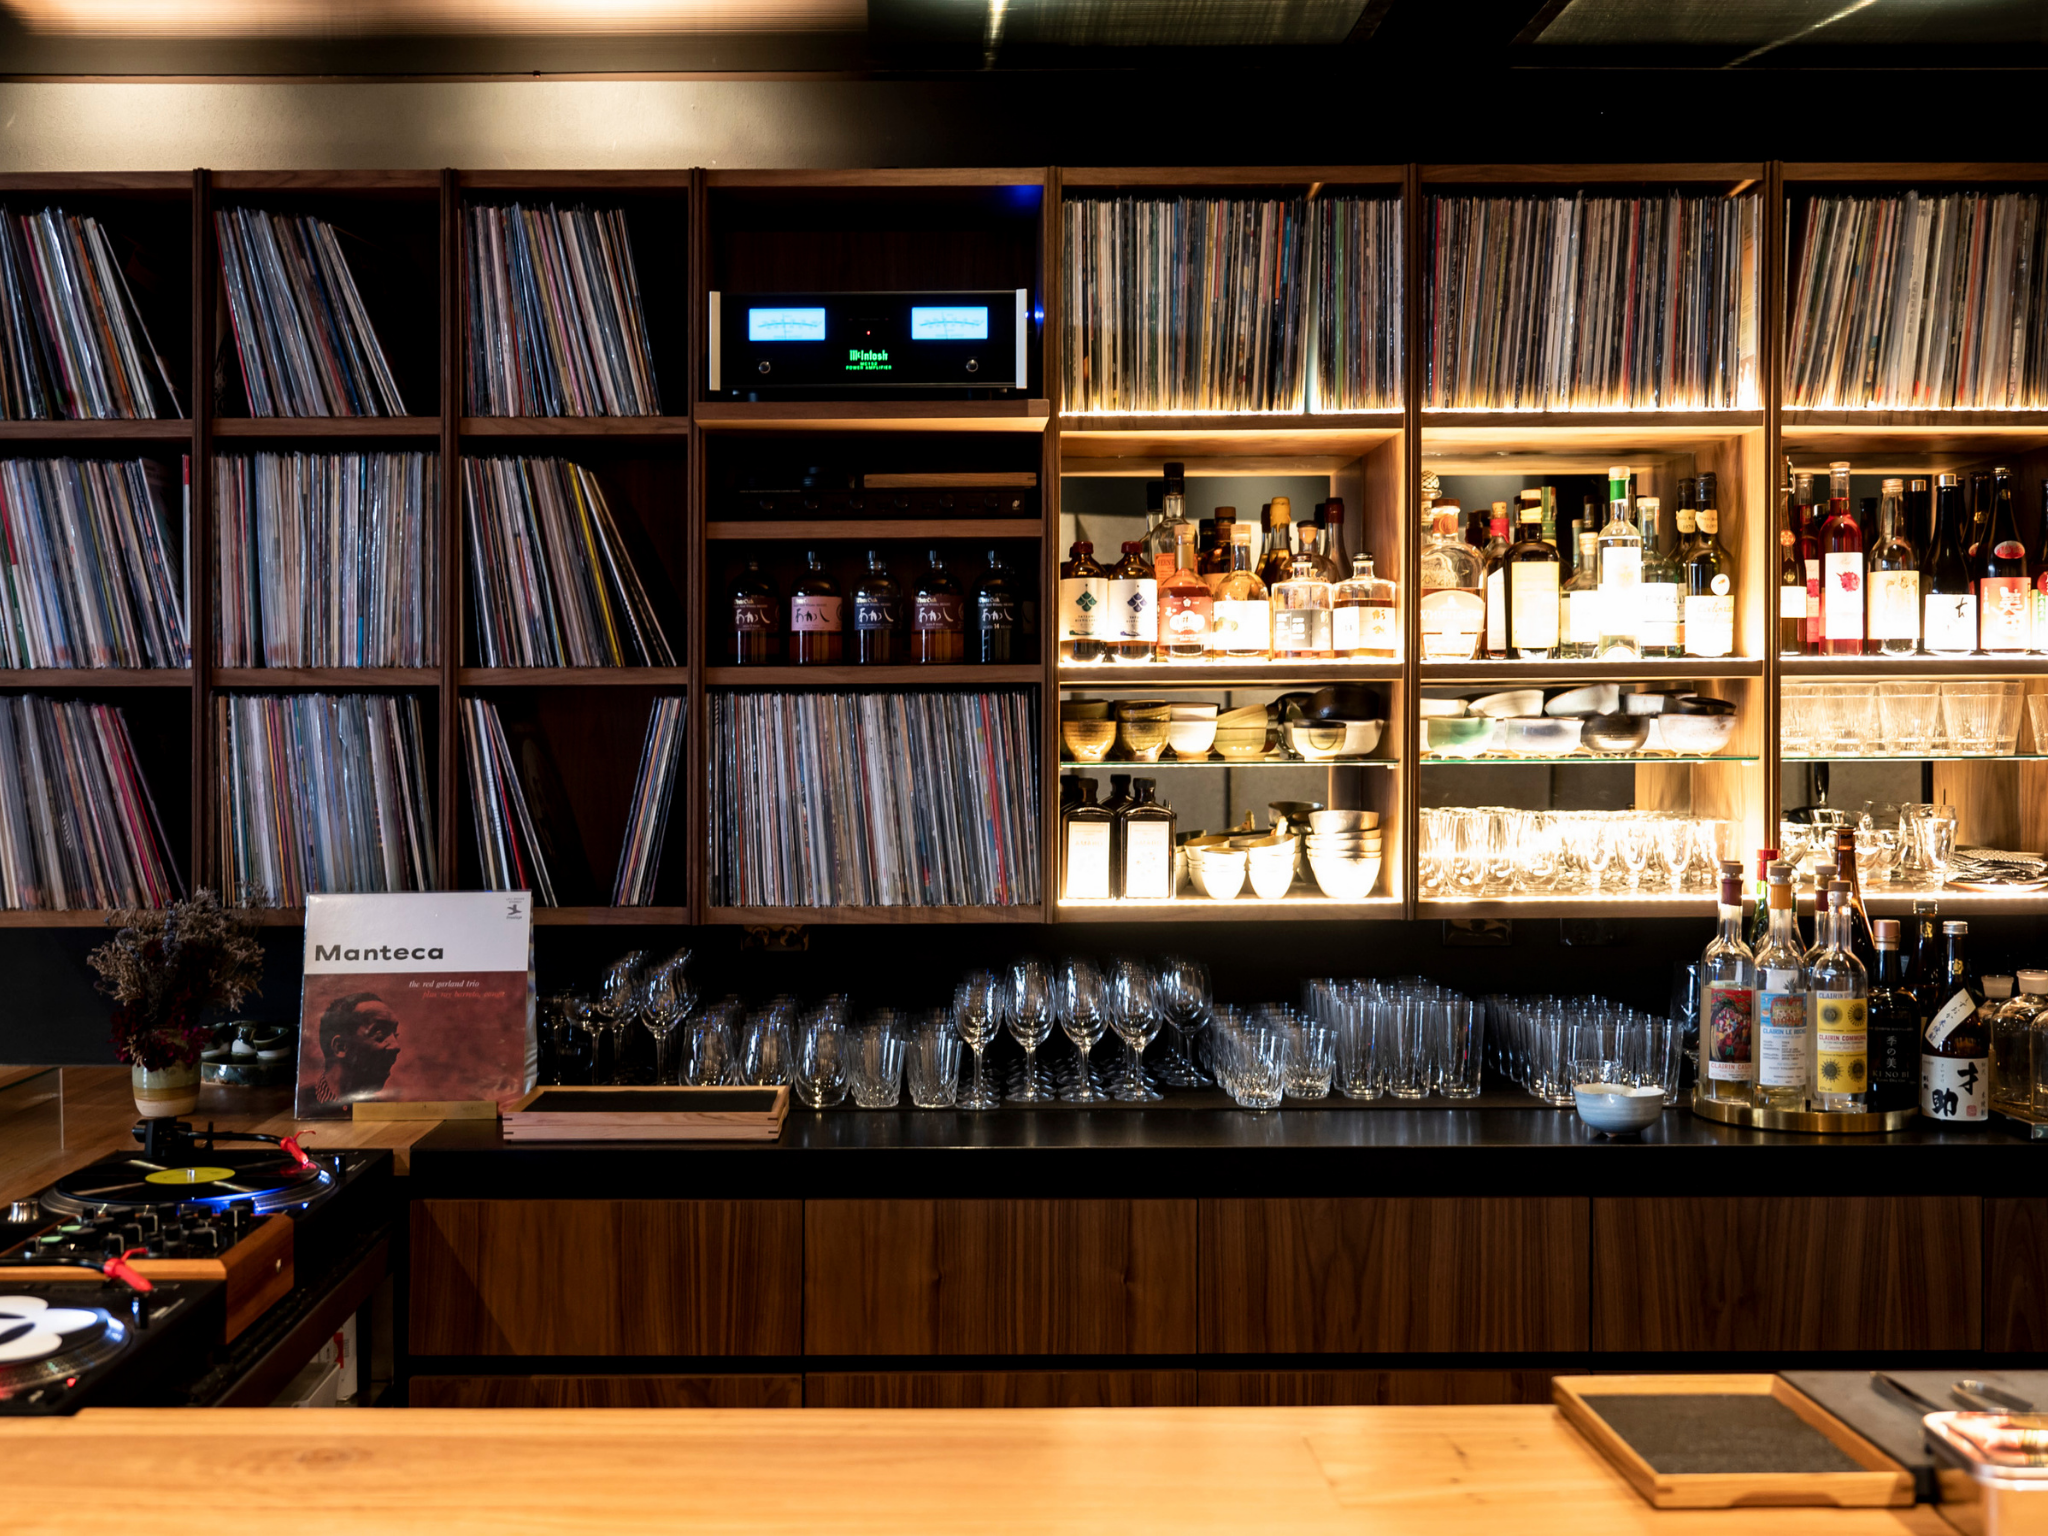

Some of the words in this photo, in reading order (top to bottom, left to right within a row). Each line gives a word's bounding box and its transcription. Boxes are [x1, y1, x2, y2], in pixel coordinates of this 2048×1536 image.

[314, 944, 444, 961] Manteca
[409, 980, 420, 988] the
[422, 980, 435, 988] red
[436, 980, 465, 989] garland
[466, 980, 480, 988] trio
[1710, 1062, 1736, 1070] CLAIRIN
